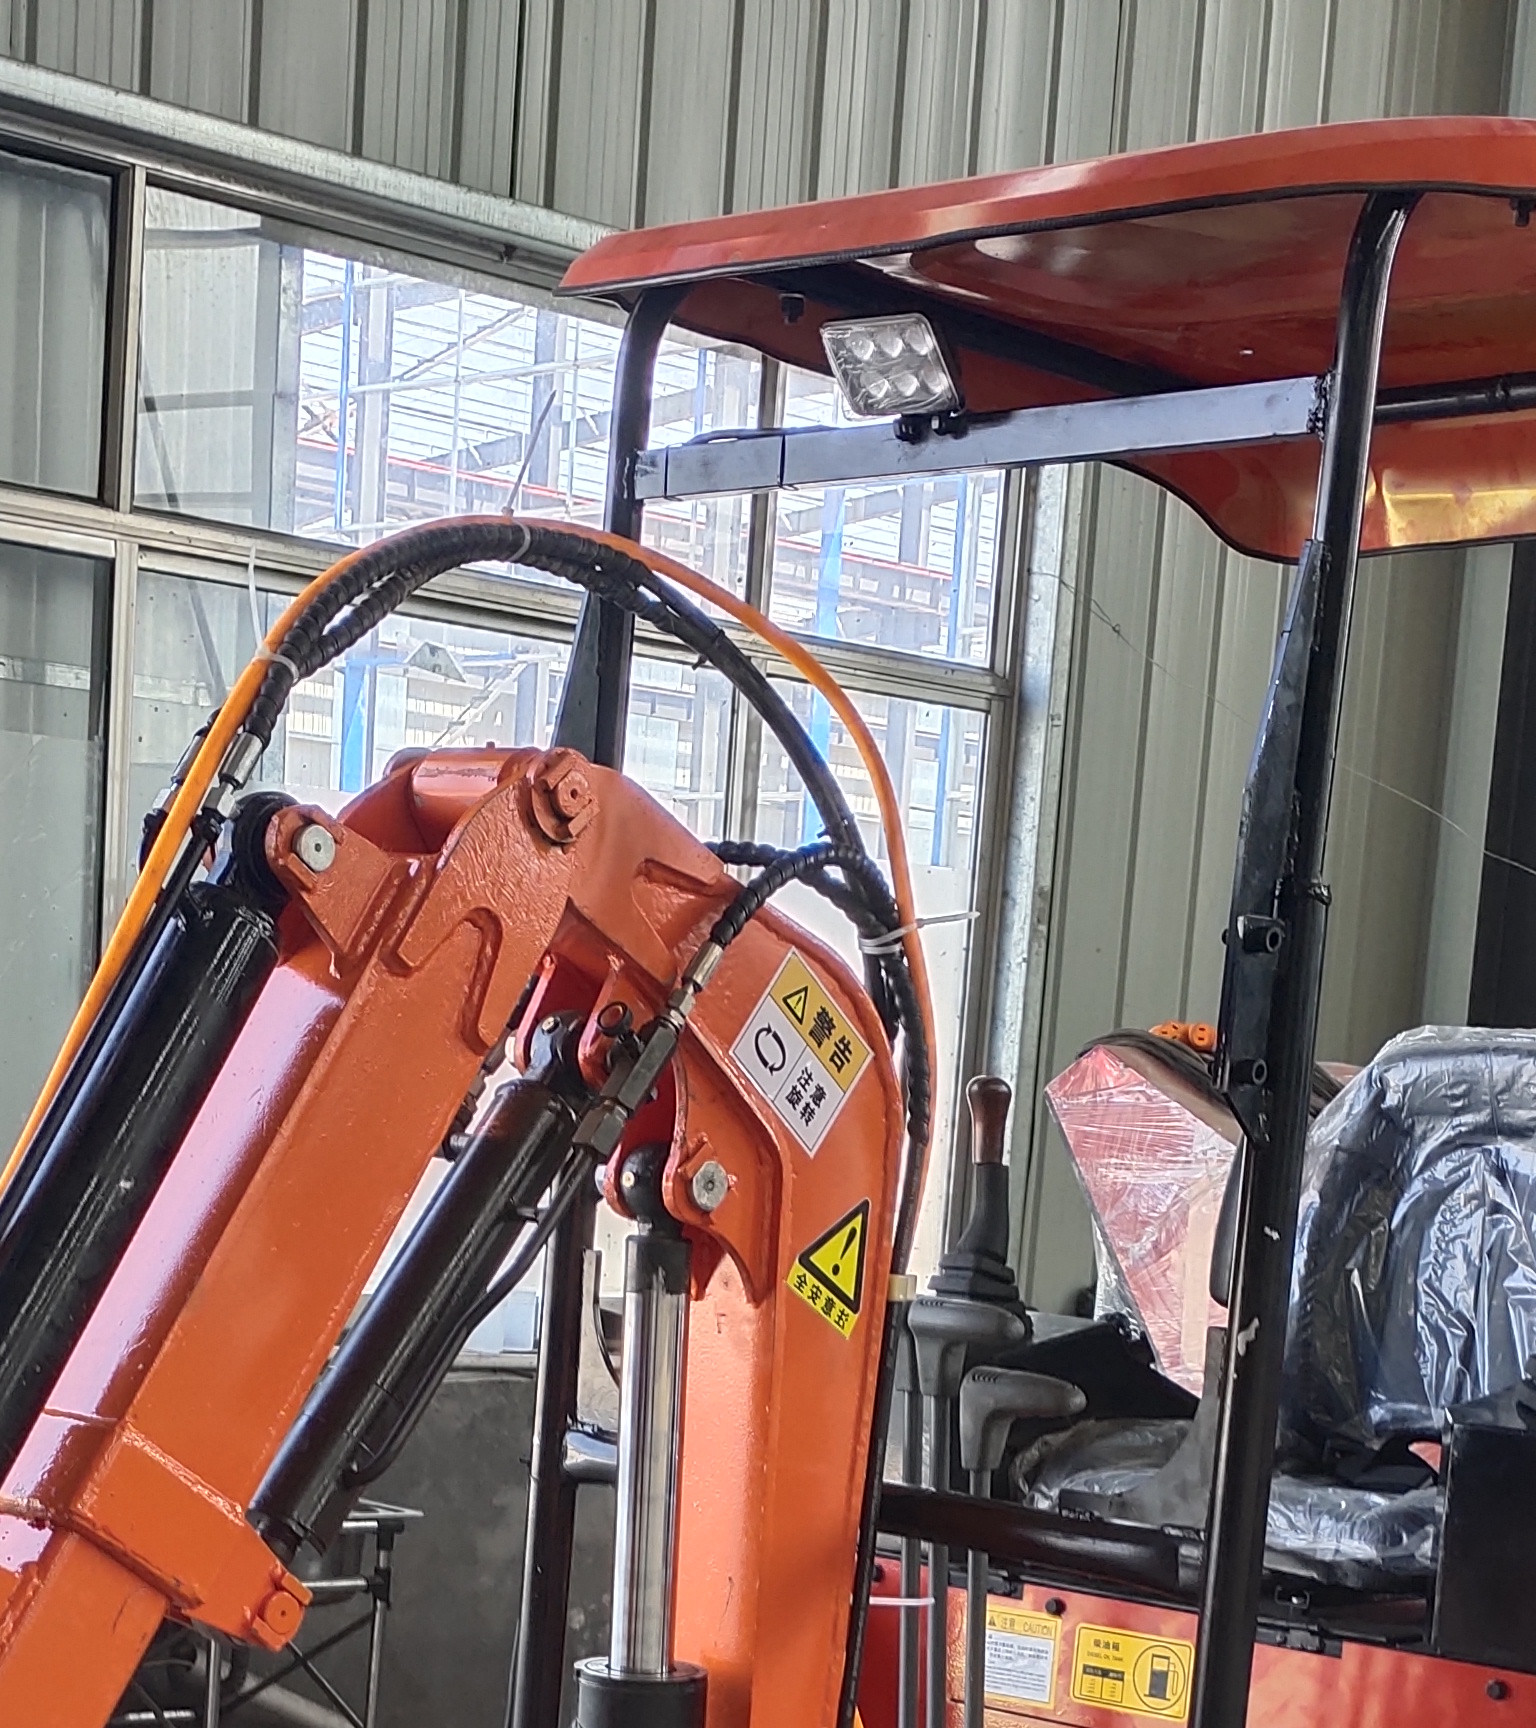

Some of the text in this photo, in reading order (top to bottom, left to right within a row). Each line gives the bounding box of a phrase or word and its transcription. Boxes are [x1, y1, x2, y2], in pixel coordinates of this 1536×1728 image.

[808, 1005, 853, 1074] 警告
[785, 1085, 817, 1127] 旋转
[796, 1066, 827, 1108] 注意
[1022, 1621, 1053, 1637] CAUTION
